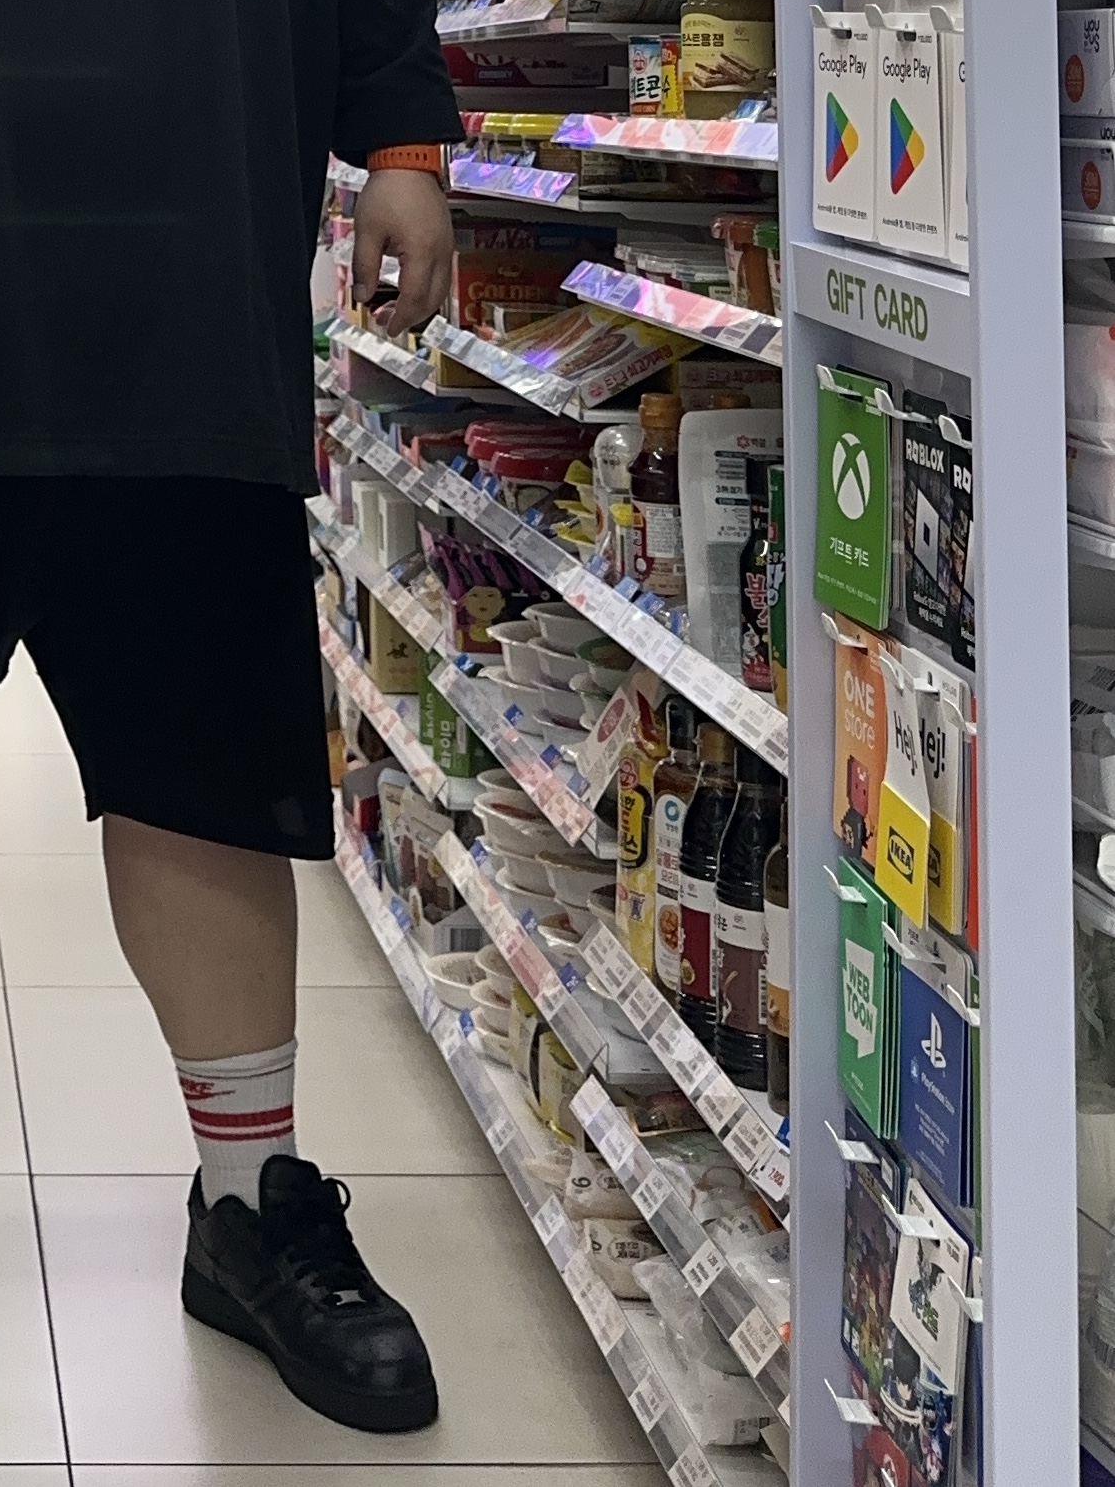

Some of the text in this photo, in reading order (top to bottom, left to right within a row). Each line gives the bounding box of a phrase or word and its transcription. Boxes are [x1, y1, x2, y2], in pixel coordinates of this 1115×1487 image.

[819, 52, 867, 78] Google Play
[883, 56, 912, 83] Google
[913, 57, 931, 84] Play
[826, 268, 929, 342] GIFT CARD
[906, 438, 944, 474] ROBLOX
[845, 669, 875, 720] ONE
[845, 709, 875, 751] store
[890, 838, 913, 871] IKEA
[847, 962, 870, 1004] WEB
[846, 983, 873, 1033] TOON
